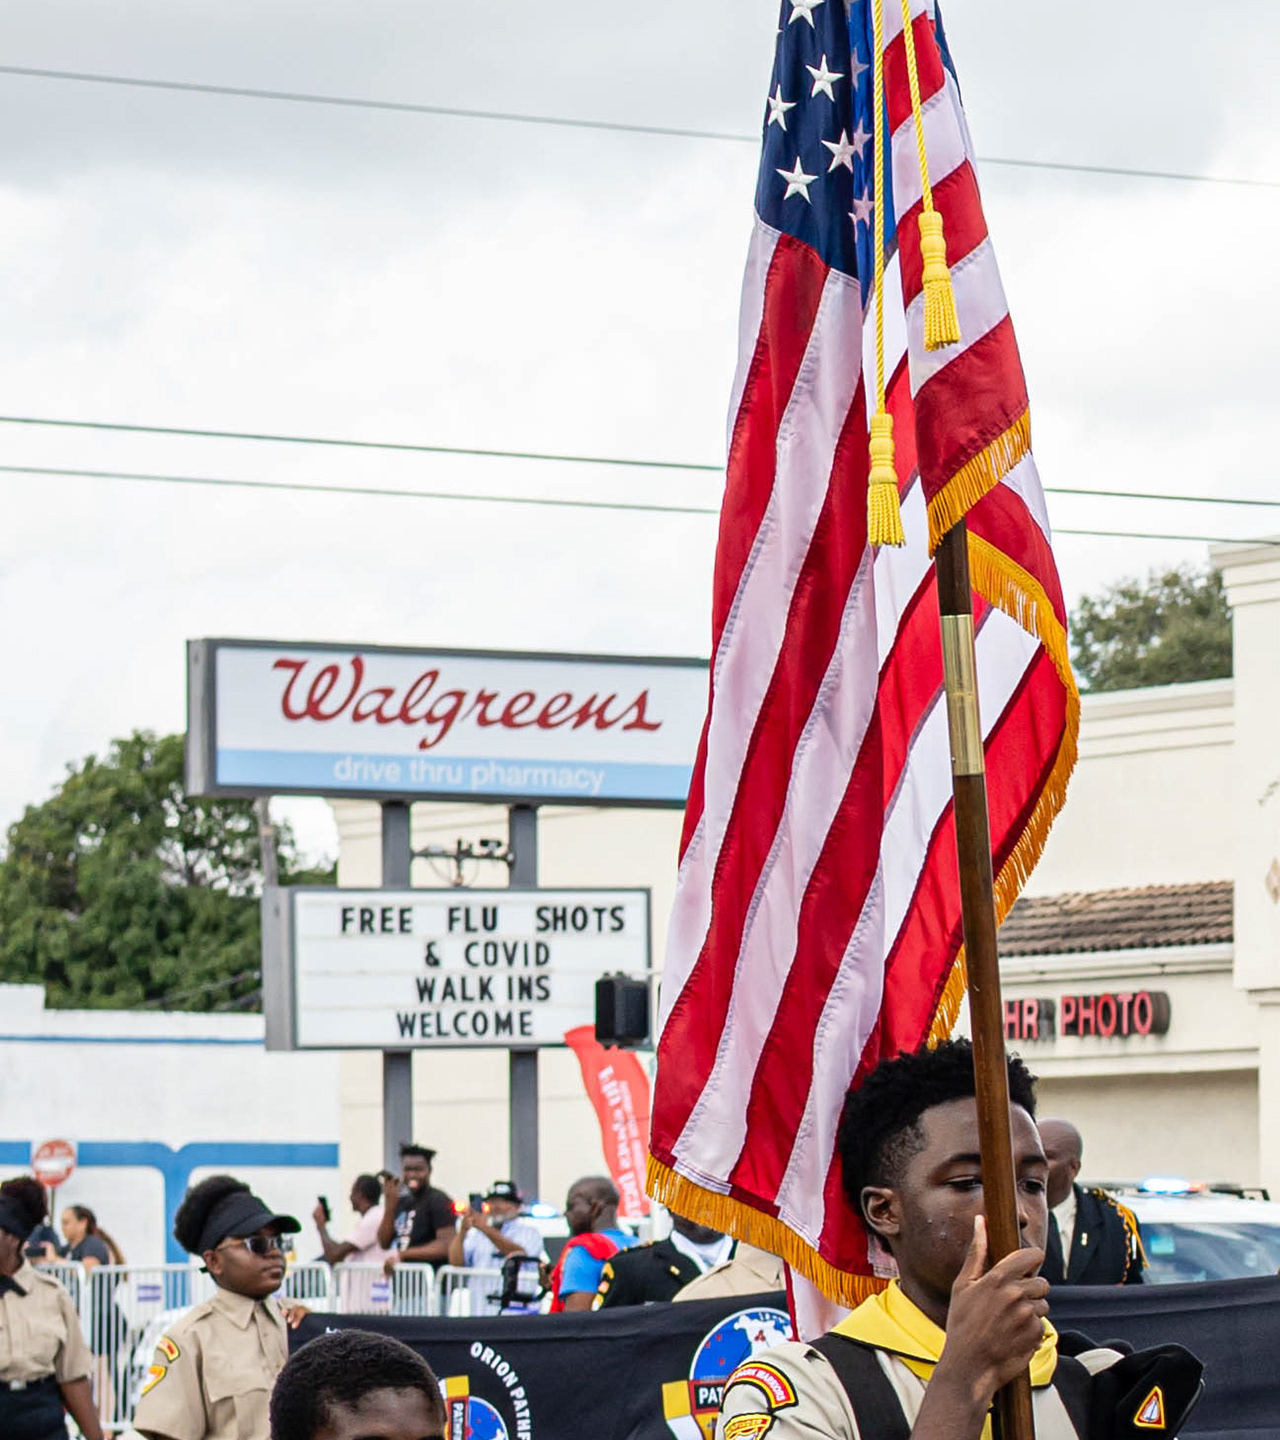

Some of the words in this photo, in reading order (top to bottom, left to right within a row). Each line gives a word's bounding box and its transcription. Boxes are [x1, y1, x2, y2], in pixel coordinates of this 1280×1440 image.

[272, 655, 662, 750] Walgreens
[334, 756, 400, 783] drive
[410, 758, 462, 785] thru
[471, 760, 605, 795] pharmacy
[341, 907, 412, 933] FREE
[449, 907, 498, 933] FLU
[536, 906, 625, 932] SHOTS
[425, 941, 441, 968] &
[464, 941, 550, 967] COVID
[416, 976, 493, 1002] WALK
[508, 975, 550, 1001] INS
[397, 1011, 533, 1038] WELCOME
[1004, 998, 1039, 1040] HR
[1061, 990, 1153, 1037] PHOTO
[470, 1341, 519, 1388] ORION
